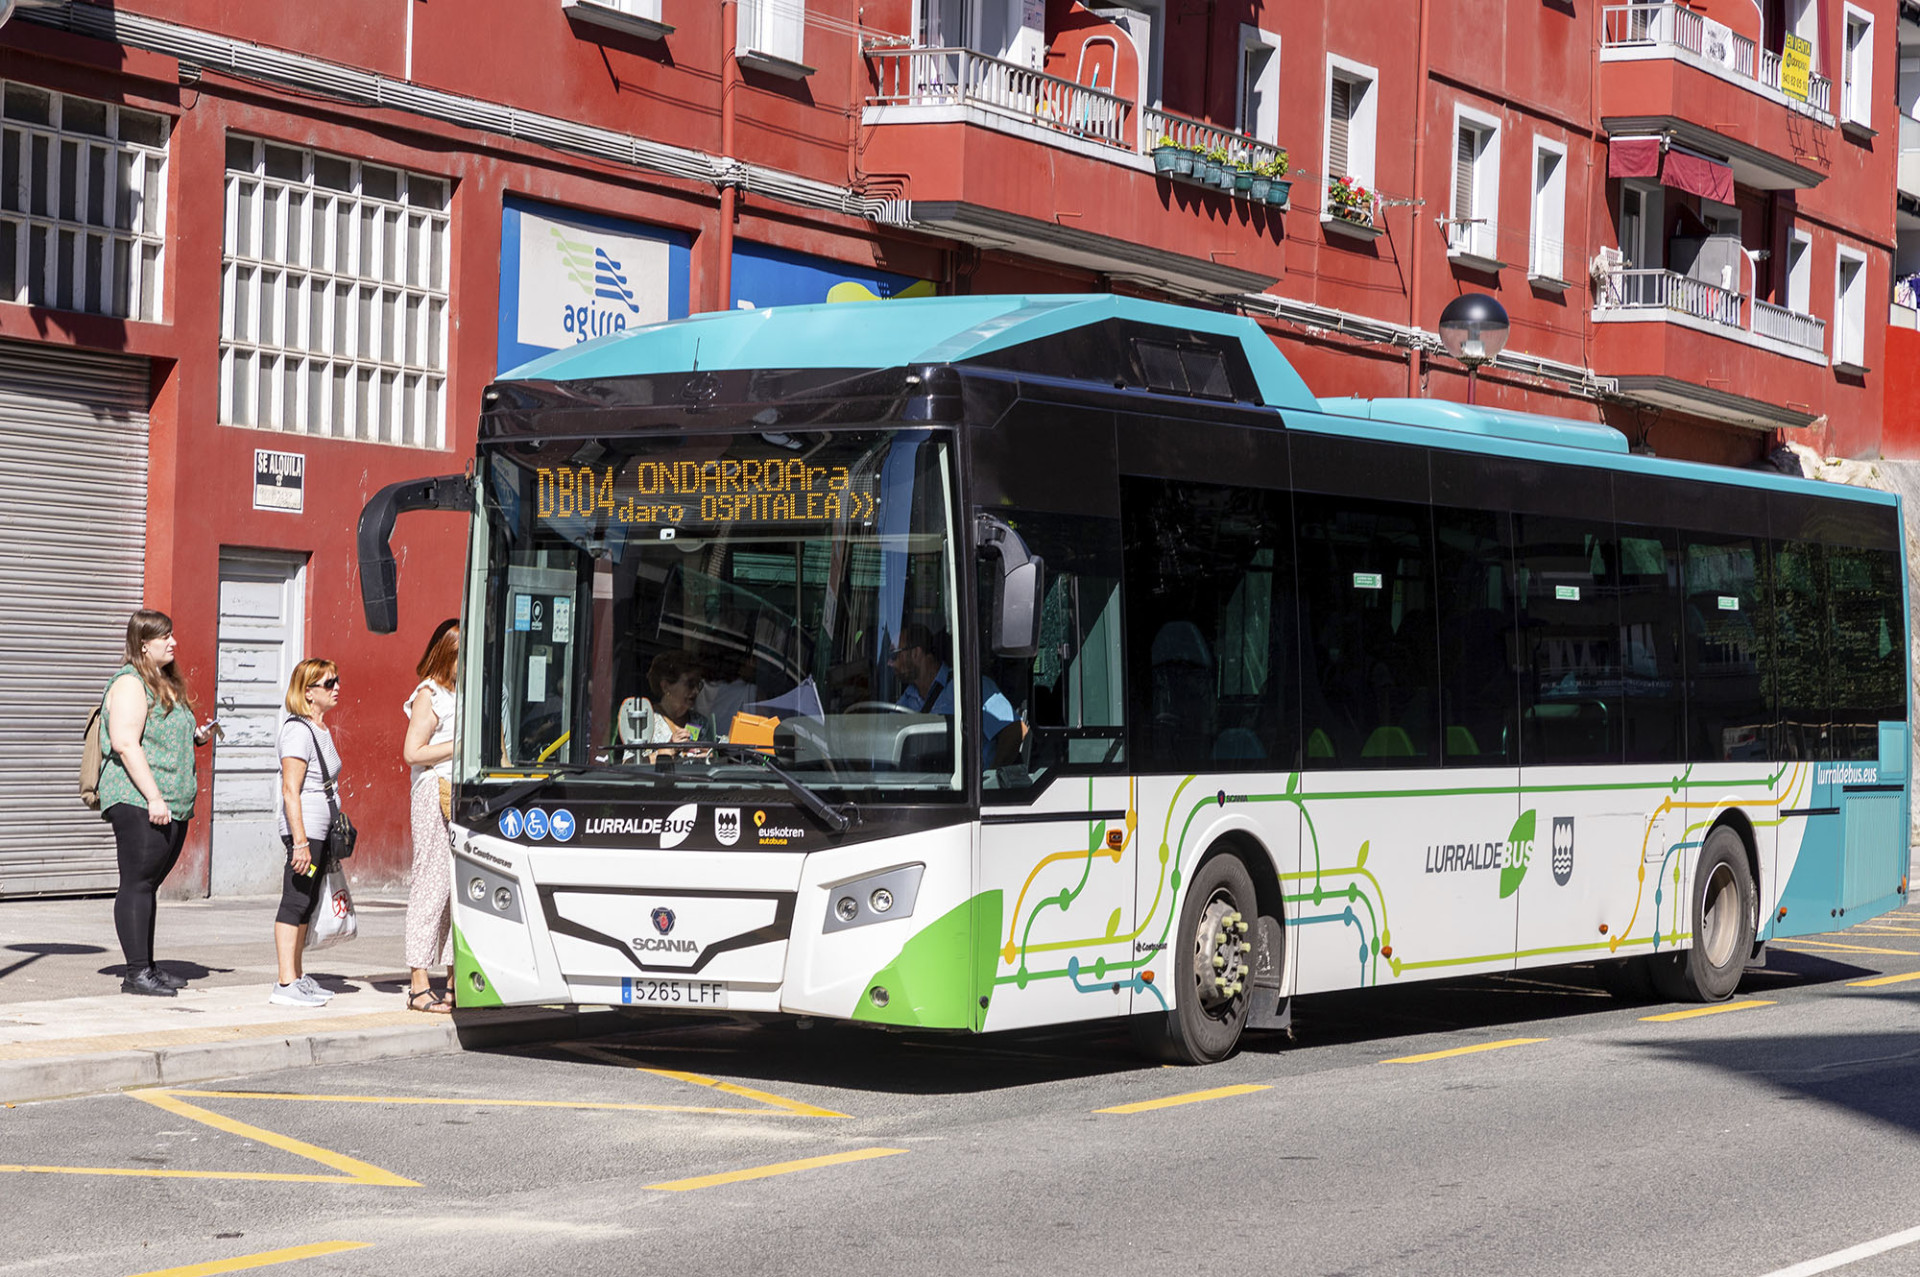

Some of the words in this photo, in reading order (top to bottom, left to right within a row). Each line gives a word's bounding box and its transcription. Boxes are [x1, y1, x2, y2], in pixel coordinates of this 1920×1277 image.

[563, 300, 626, 344] agirre
[257, 452, 268, 474] SE
[269, 453, 302, 478] ALQUILA
[536, 466, 616, 518] DB04
[637, 457, 849, 494] ONDARROAra
[618, 497, 685, 523] daro
[700, 492, 841, 521] OSPITALEA
[1817, 762, 1877, 785] lurraldebus.eus
[585, 818, 695, 834] LURRALDEBUS
[758, 826, 805, 838] euskotren
[758, 837, 788, 845] autobusa
[1425, 840, 1535, 873] LURRALDEBUS
[632, 937, 699, 953] SCANIA
[635, 980, 681, 1002] 5265
[687, 982, 723, 1004] LFF
